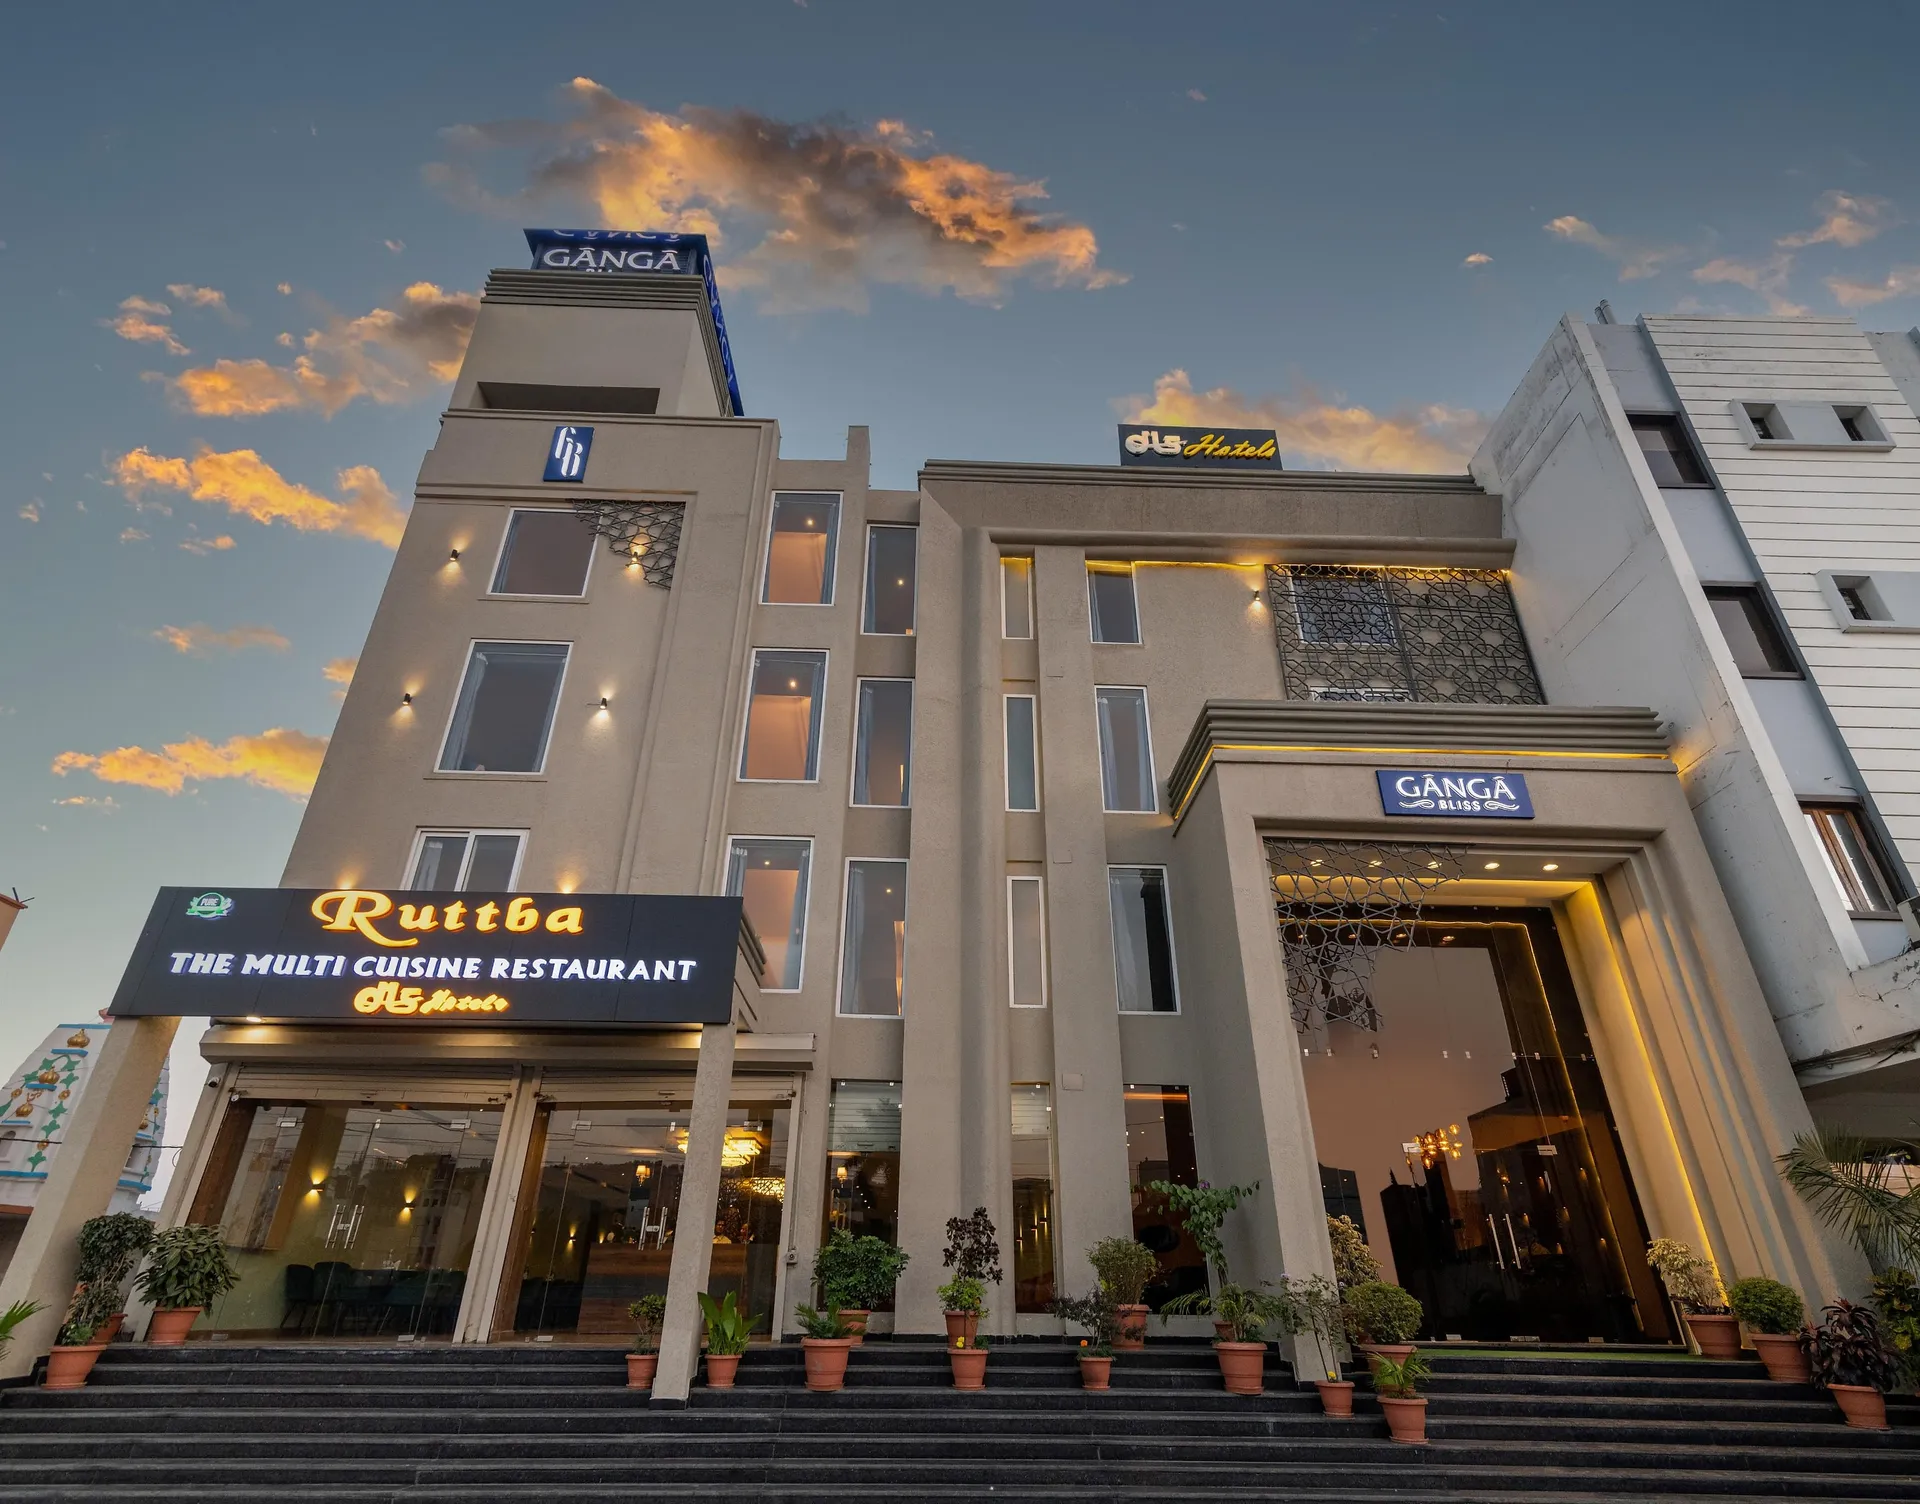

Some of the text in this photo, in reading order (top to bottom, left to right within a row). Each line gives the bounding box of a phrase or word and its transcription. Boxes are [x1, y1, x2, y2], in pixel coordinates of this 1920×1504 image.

[1183, 434, 1276, 460] Hotels
[1438, 800, 1481, 811] BLISS
[311, 889, 584, 948] Ruttba
[170, 952, 698, 981] THE MULTI CUISINE RESTAURANT
